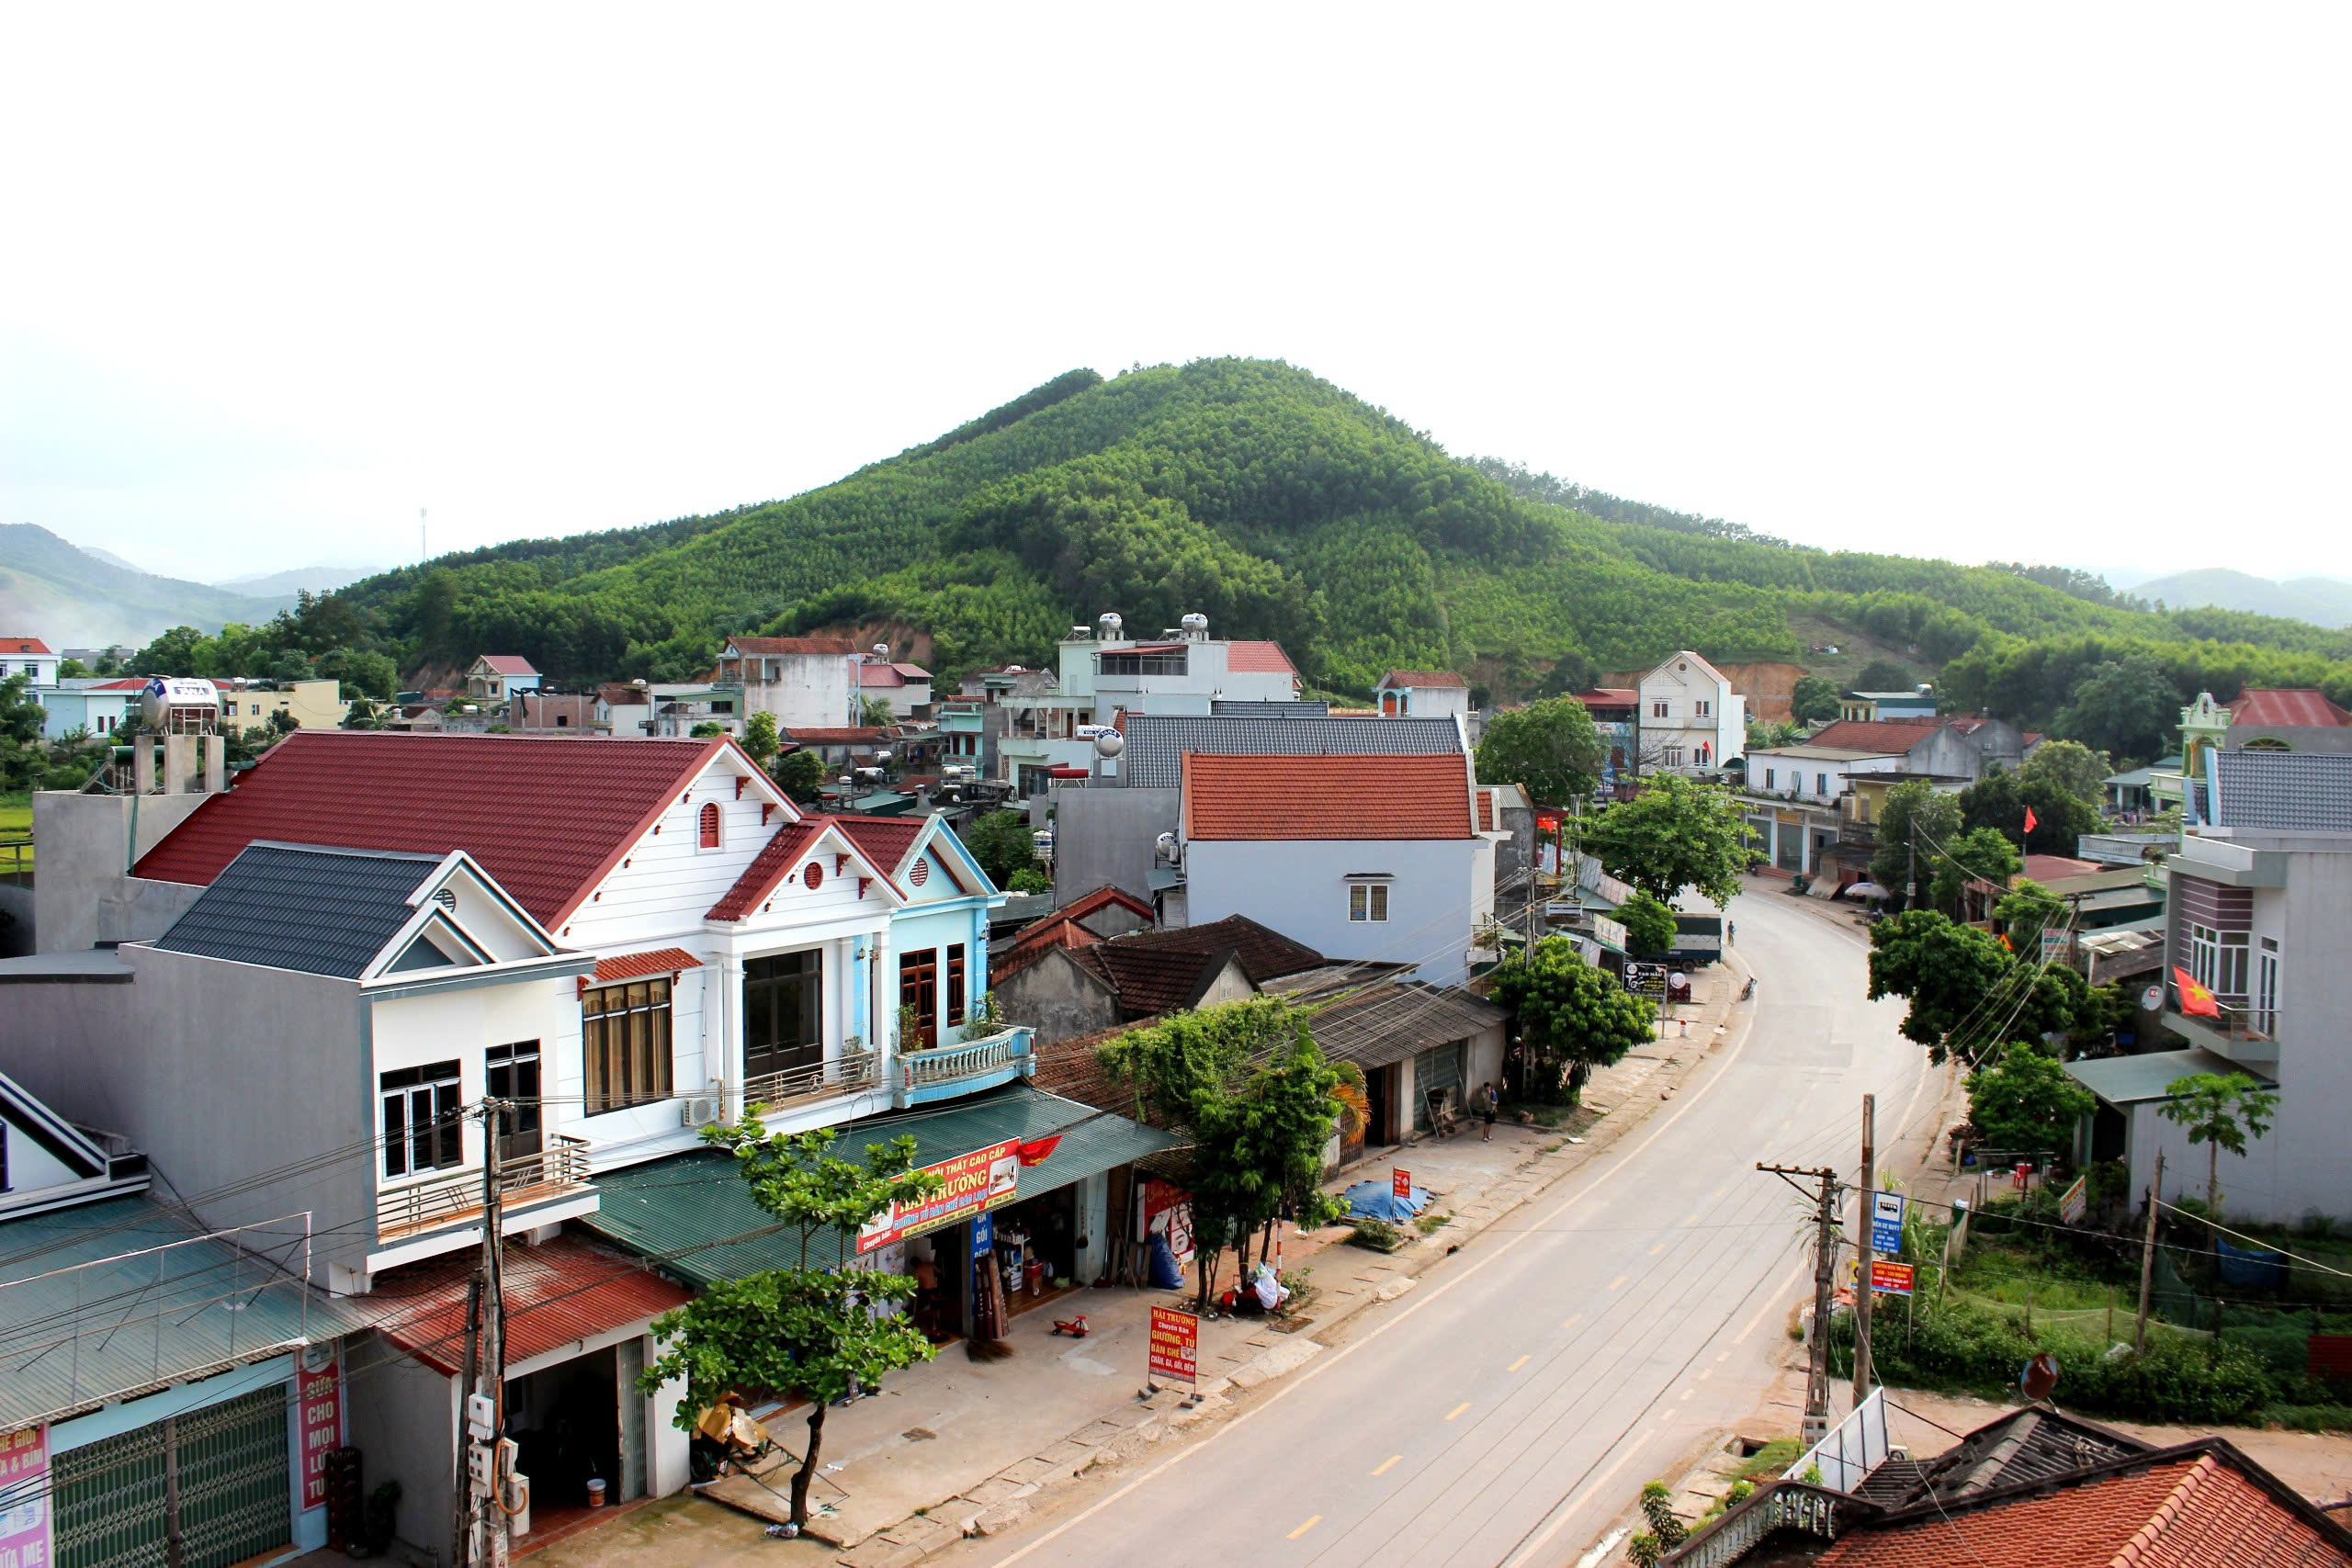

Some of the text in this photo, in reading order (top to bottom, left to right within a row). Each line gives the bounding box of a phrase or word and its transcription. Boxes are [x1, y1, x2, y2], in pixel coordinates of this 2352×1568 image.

[945, 1157, 967, 1175] THẤT
[969, 1153, 987, 1168] CAO
[989, 1145, 1006, 1161] CẤP
[976, 1224, 988, 1244] GỐI
[1153, 1308, 1195, 1326] HẢI TRƯỜNG
[1150, 1342, 1180, 1359] BÀN GHẾ
[1185, 1335, 1194, 1348] TỦ
[308, 1401, 334, 1425] CHO
[310, 1448, 328, 1474] LỨ
